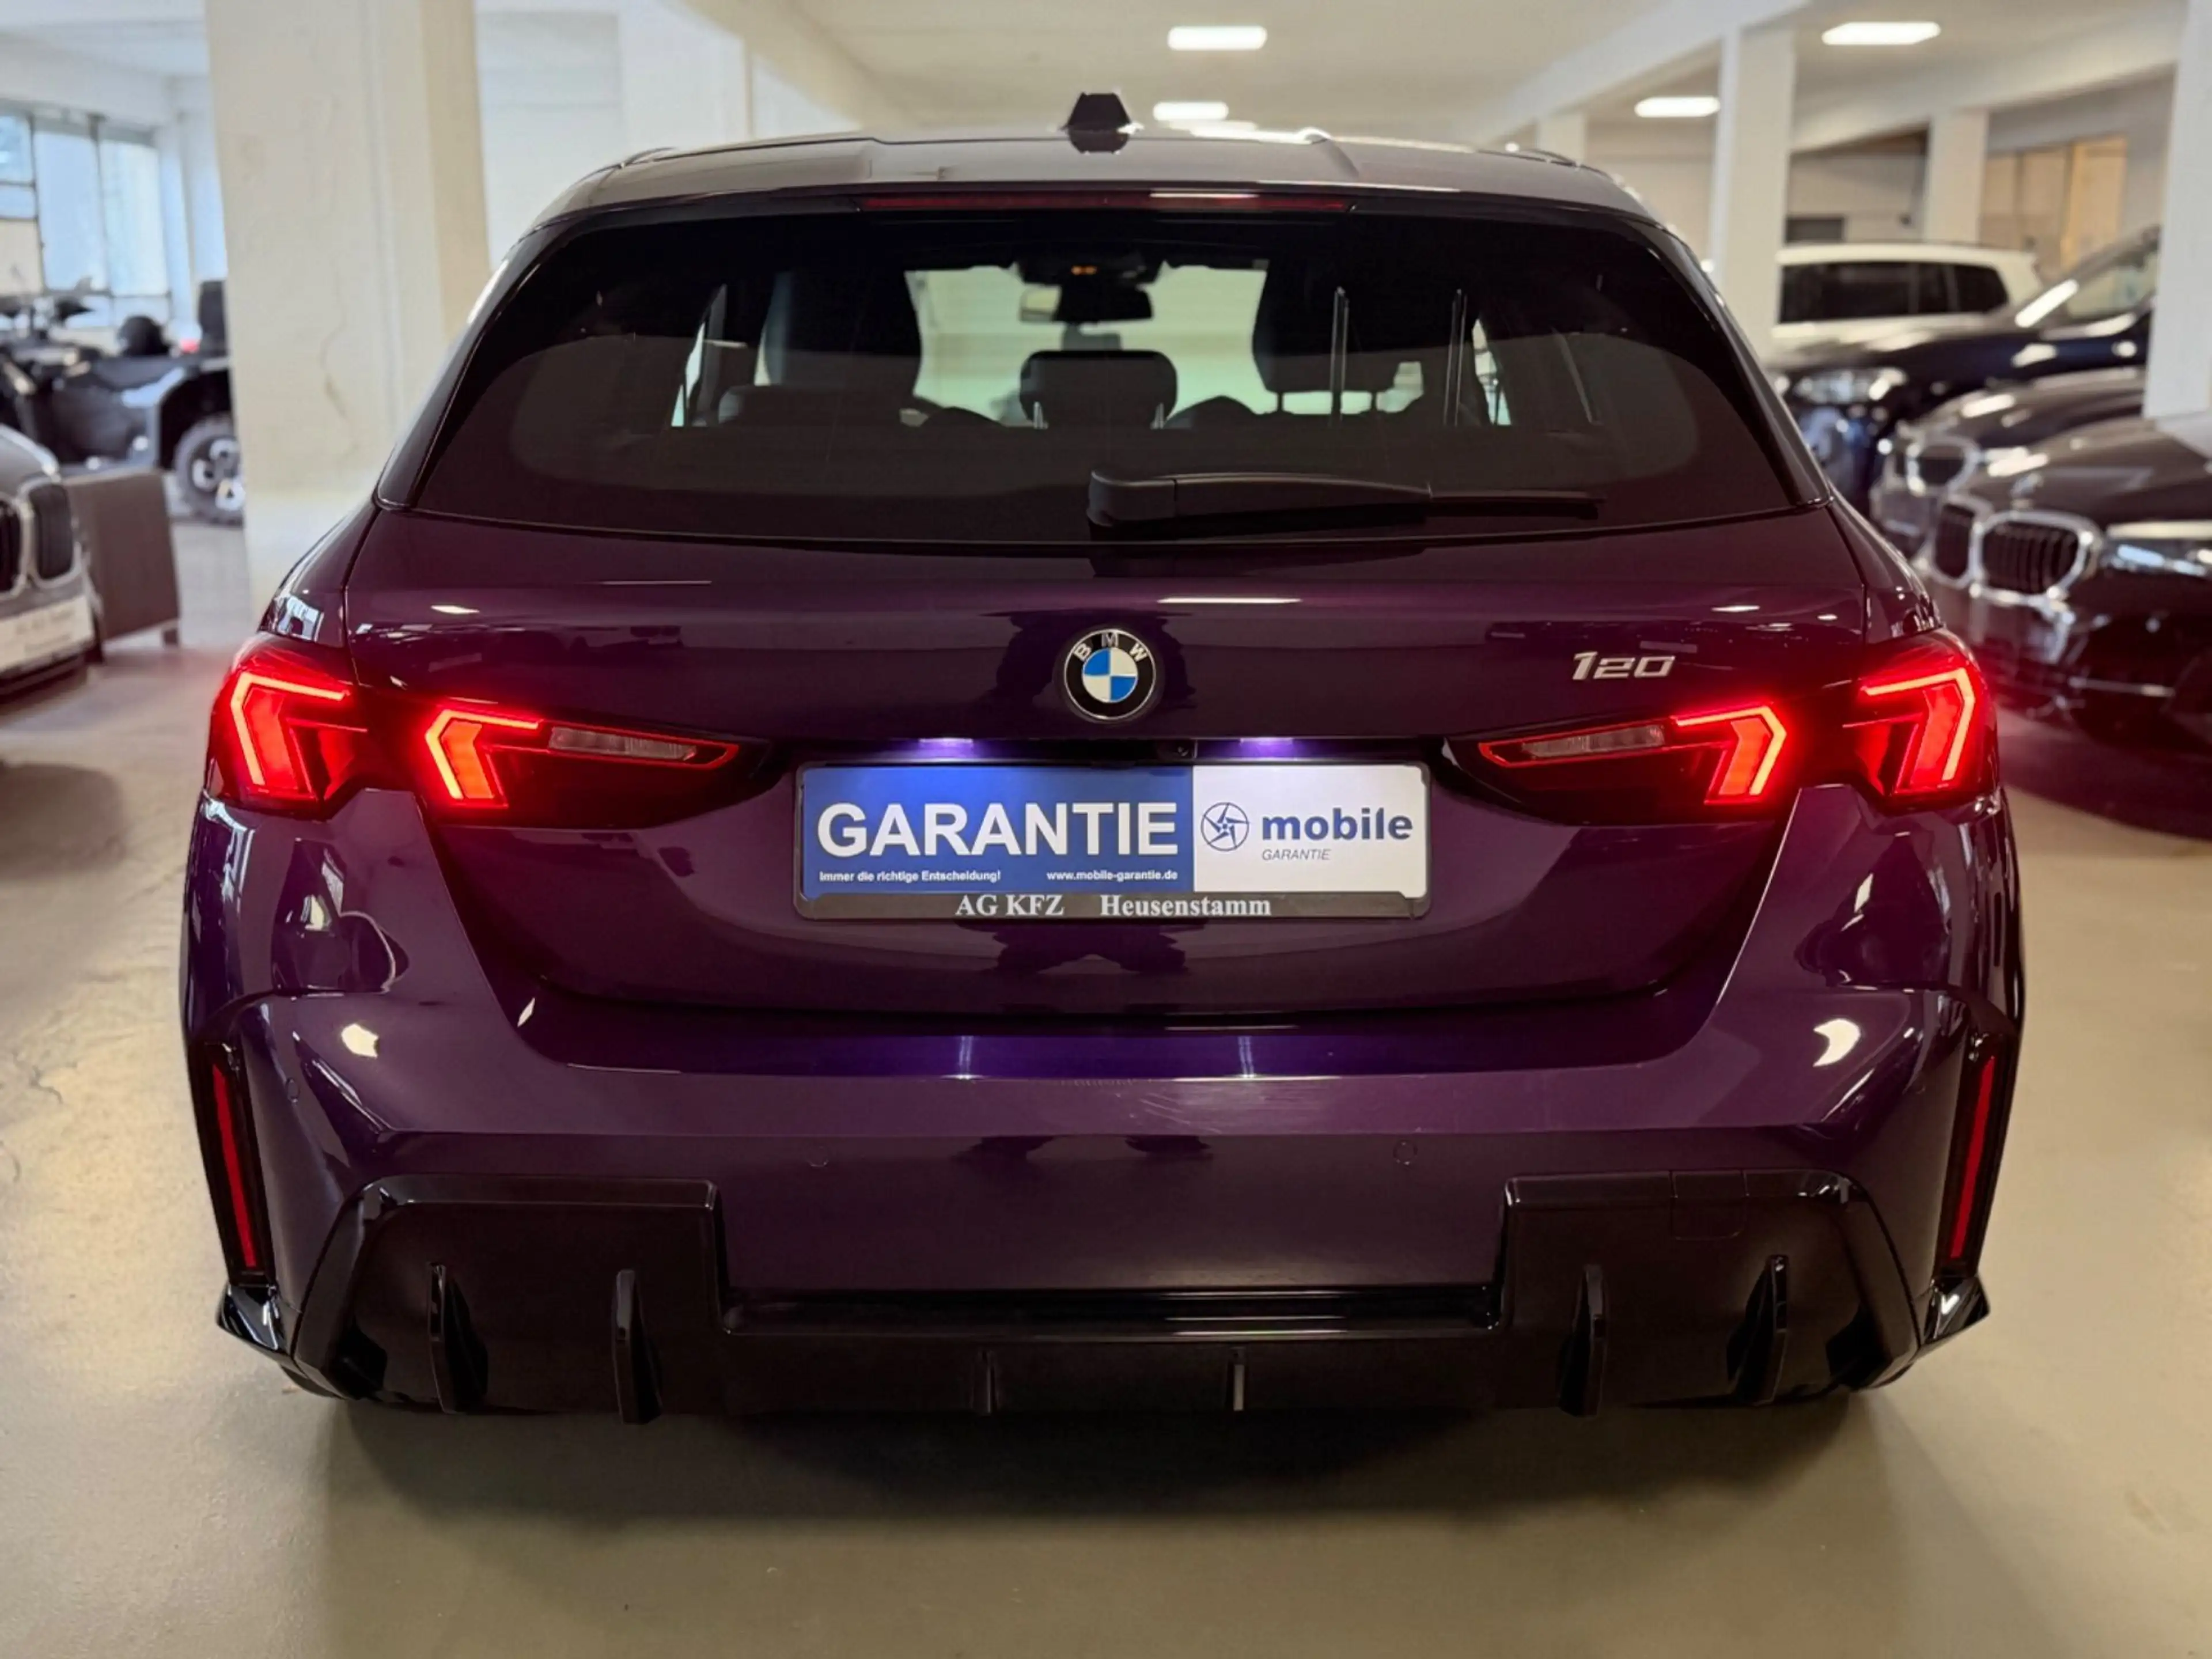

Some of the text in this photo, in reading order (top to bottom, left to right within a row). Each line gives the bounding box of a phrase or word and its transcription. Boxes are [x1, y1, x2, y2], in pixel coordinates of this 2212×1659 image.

[1073, 632, 1149, 662] BMW
[1572, 650, 1676, 680] 120
[817, 801, 1178, 857] GARANTIE
[1262, 807, 1414, 840] mobile
[1262, 848, 1331, 861] GARANTIE
[819, 869, 1001, 884] Immer die richtige Entscheidung!
[1046, 869, 1179, 882] www.mobile-garantie.de
[955, 893, 1272, 917] AG KFZ Heusenstamm
